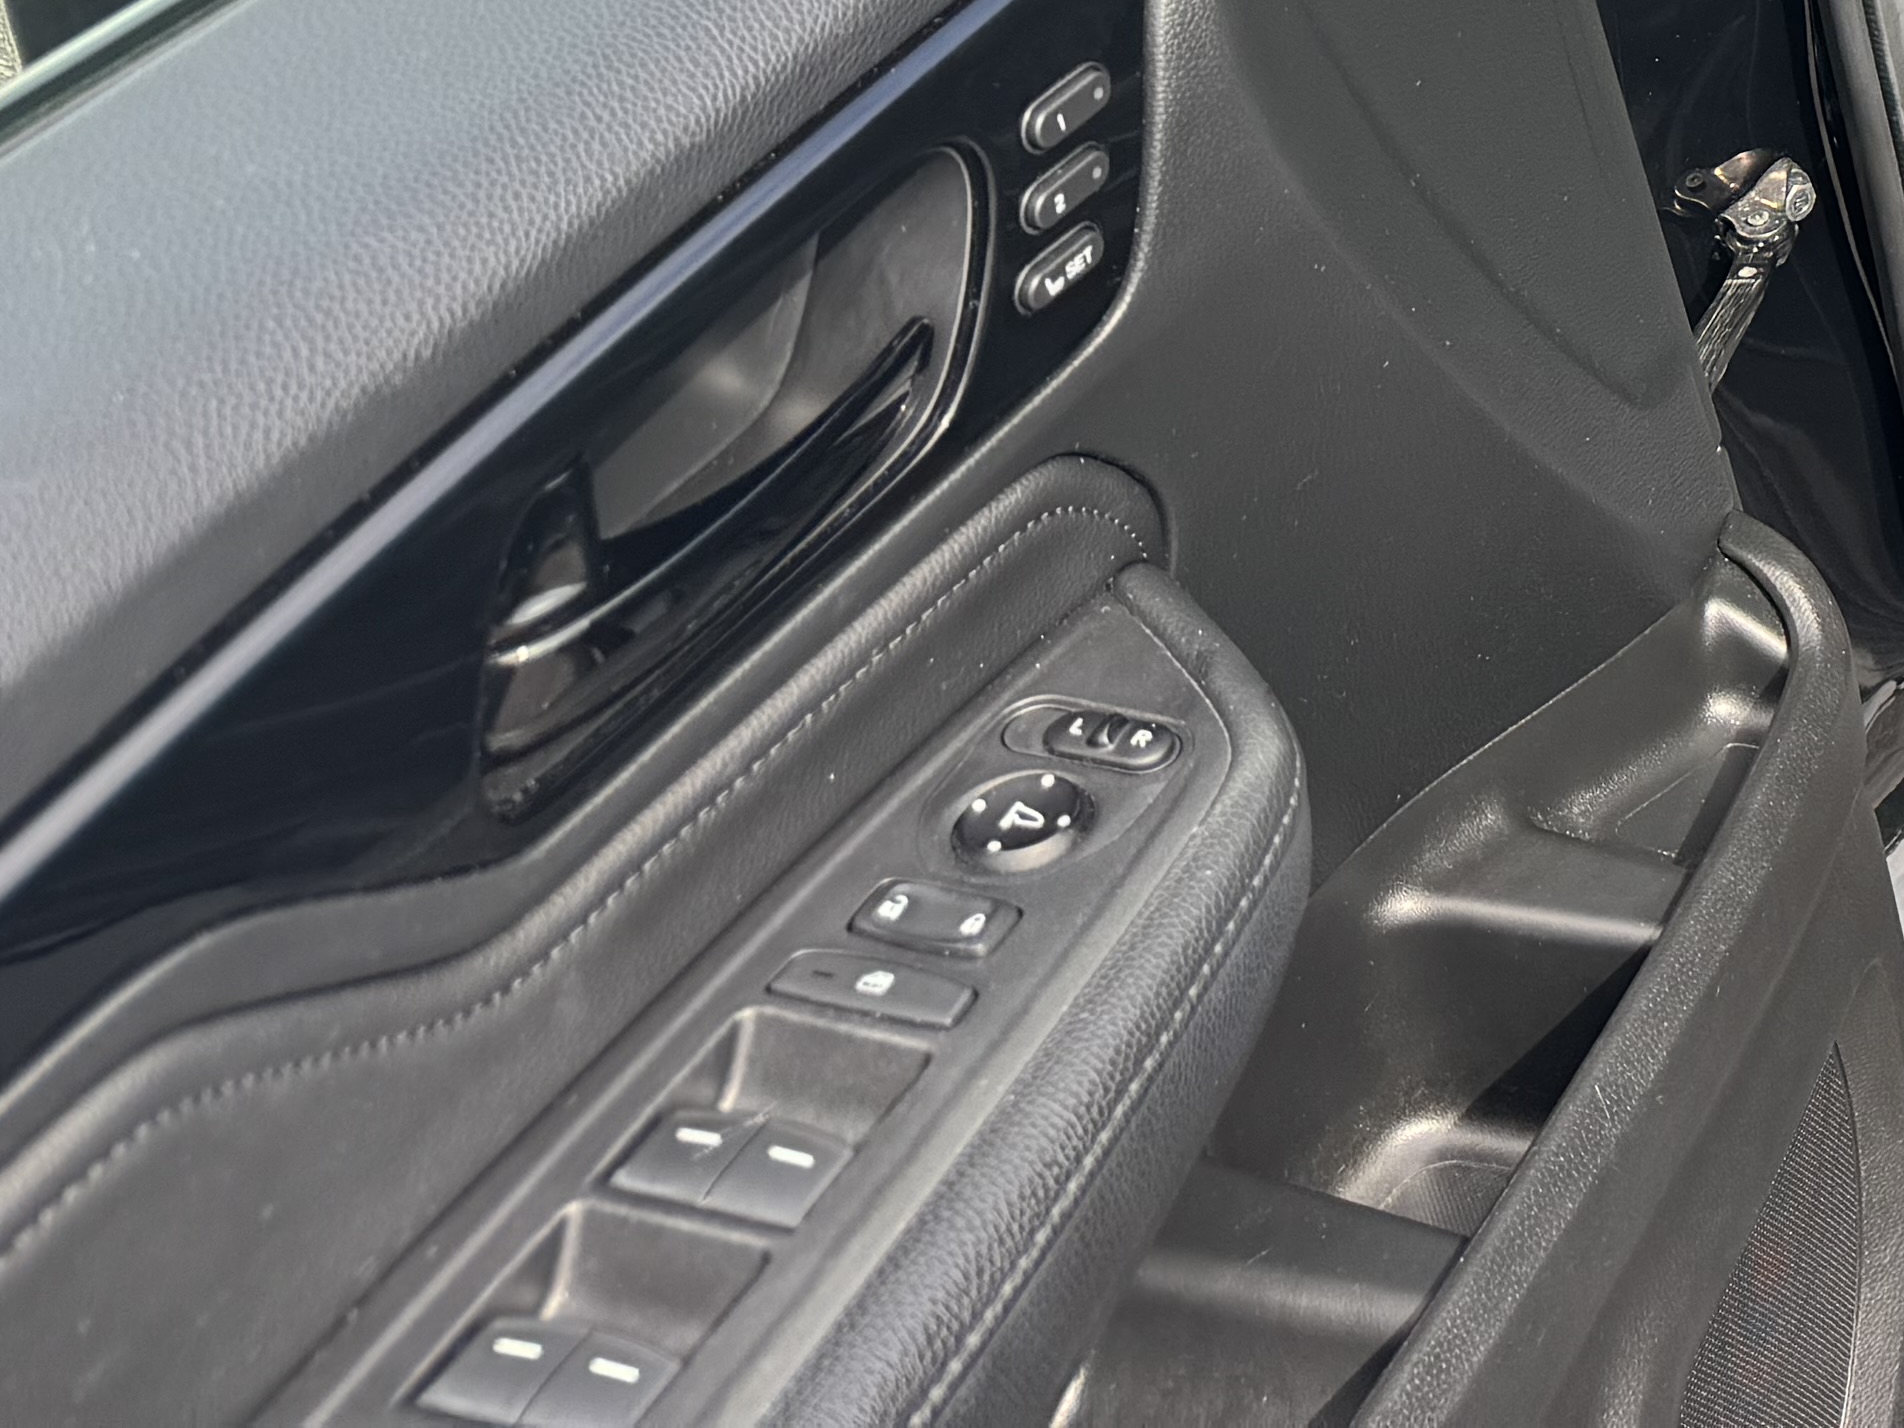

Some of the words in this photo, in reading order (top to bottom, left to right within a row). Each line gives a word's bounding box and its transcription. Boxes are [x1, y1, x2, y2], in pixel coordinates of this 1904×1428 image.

[1056, 112, 1066, 131] 1
[1054, 193, 1066, 214] 2
[1065, 245, 1093, 280] SET
[1068, 717, 1084, 736] L
[1130, 728, 1153, 747] R
